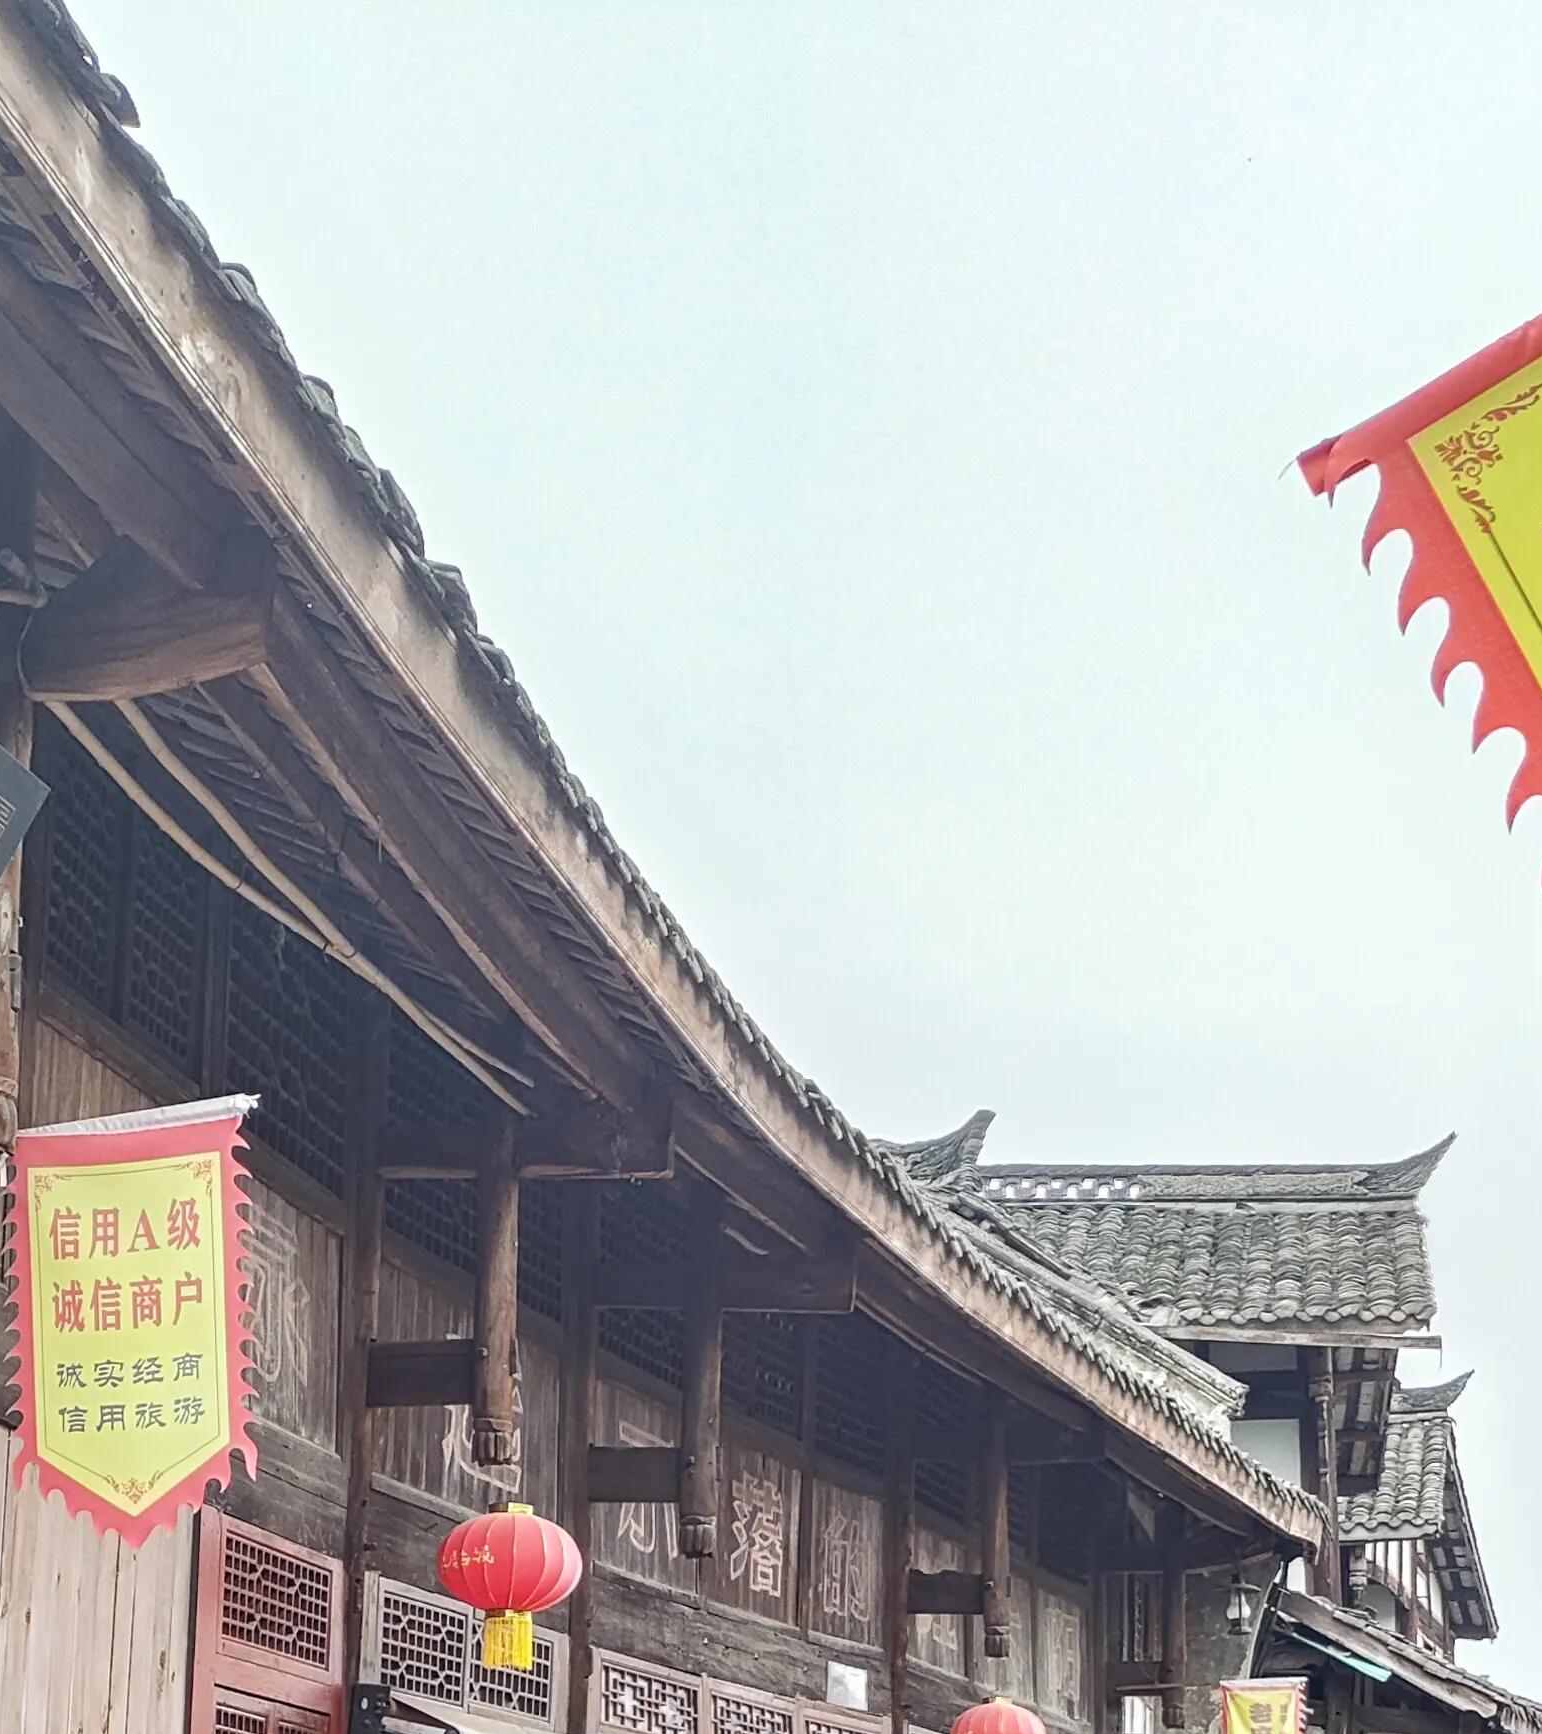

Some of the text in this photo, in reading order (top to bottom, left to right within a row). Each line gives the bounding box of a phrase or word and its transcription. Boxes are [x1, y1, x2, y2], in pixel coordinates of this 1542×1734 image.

[49, 1198, 202, 1261] 信用A级
[51, 1271, 204, 1333] 诚信商户
[56, 1352, 204, 1389] 诚实经商
[57, 1397, 206, 1433] 信用旅游
